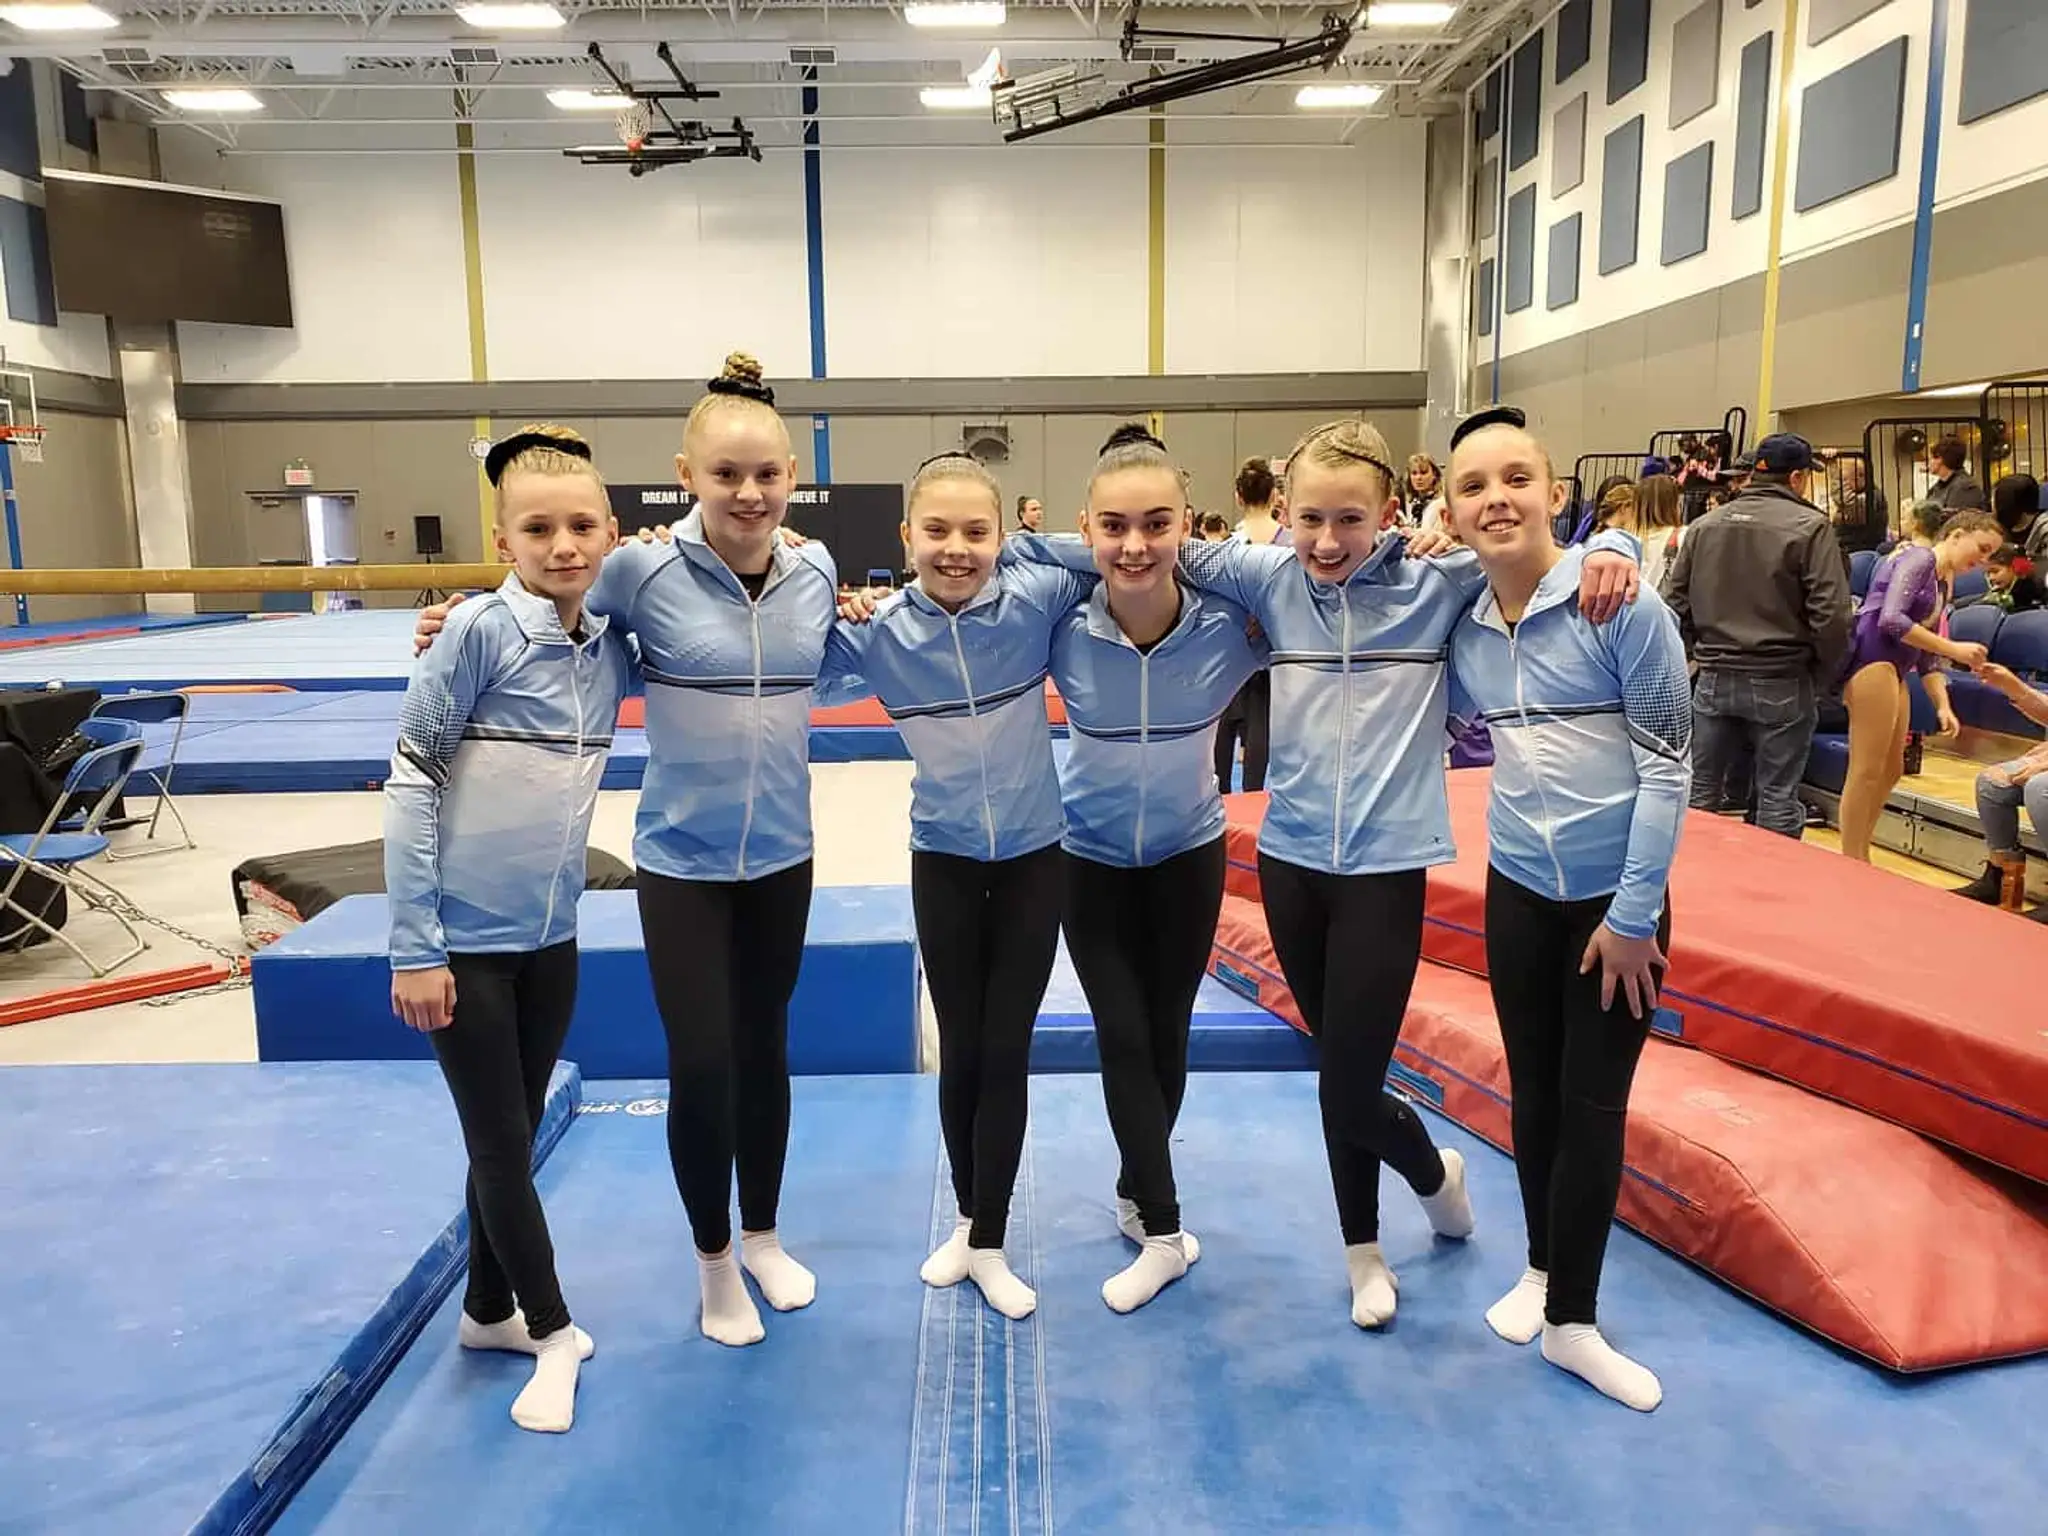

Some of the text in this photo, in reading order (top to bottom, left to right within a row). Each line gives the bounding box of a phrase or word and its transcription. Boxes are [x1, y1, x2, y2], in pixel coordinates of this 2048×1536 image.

[642, 491, 830, 504] DREAM IT HIEVE IT
